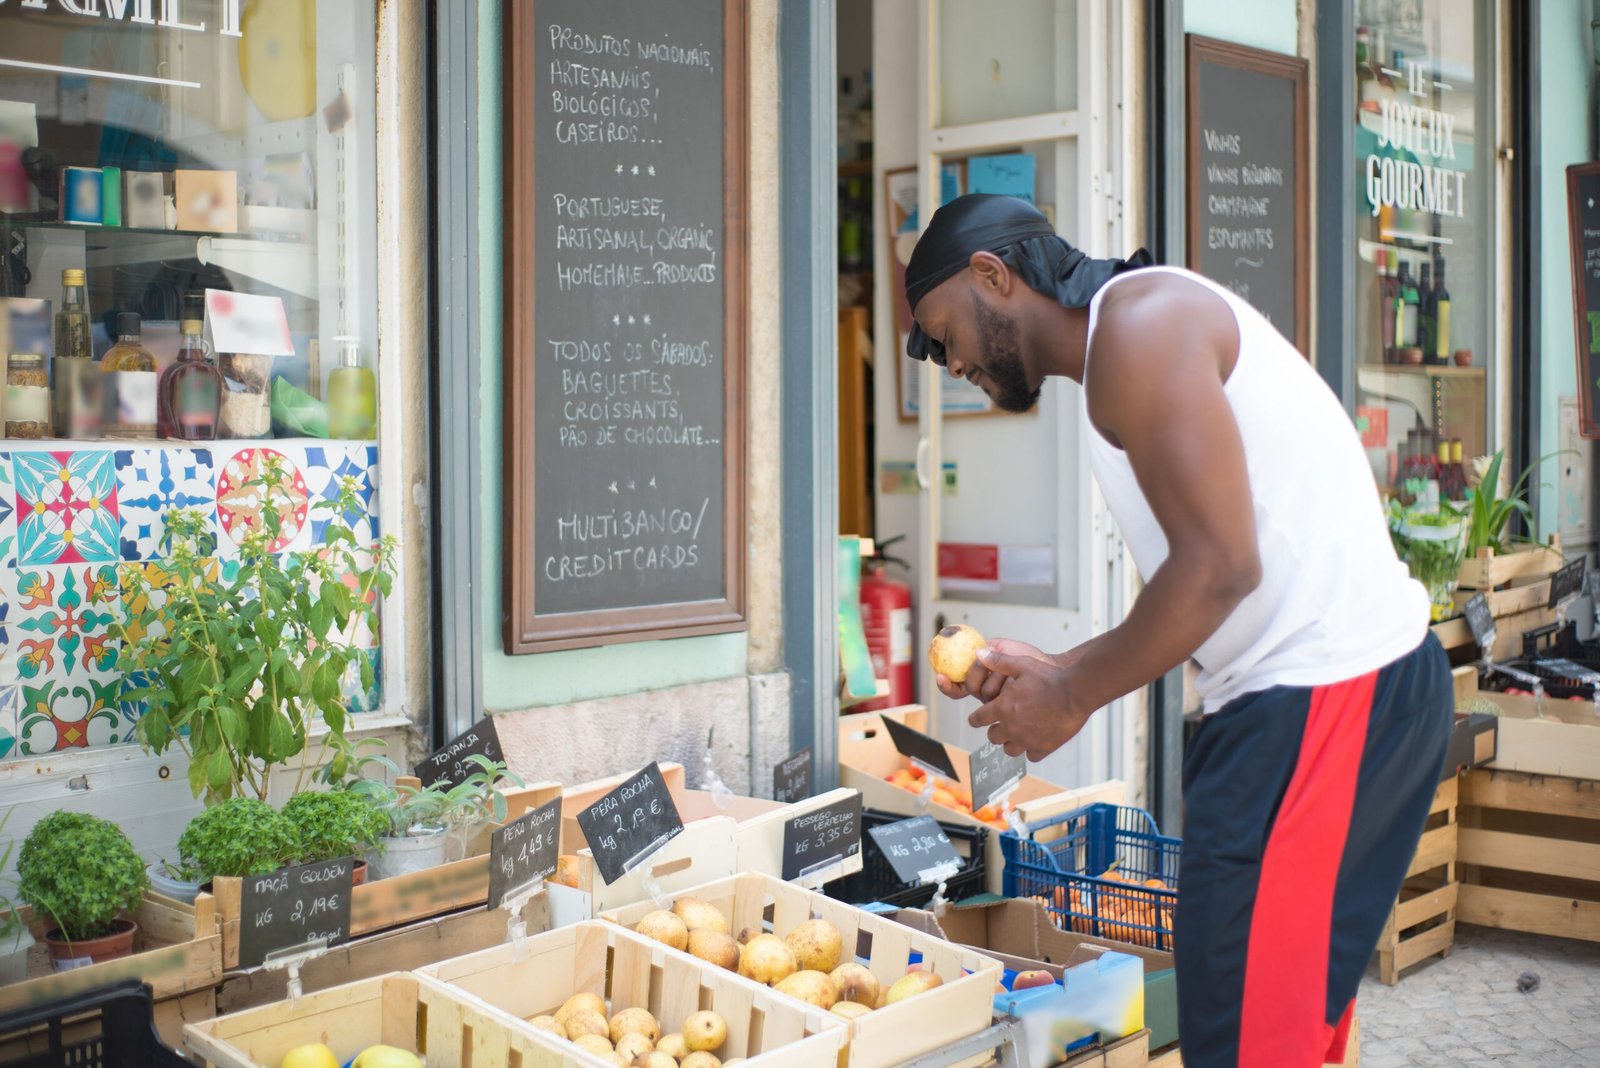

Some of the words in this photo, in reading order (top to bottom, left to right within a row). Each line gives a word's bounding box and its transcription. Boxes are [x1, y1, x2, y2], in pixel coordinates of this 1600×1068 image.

[1409, 63, 1427, 98] LE
[1377, 99, 1456, 160] JOYEUX
[1366, 154, 1466, 218] GOURMET
[548, 339, 611, 362] TODOS
[596, 426, 617, 446] DE
[545, 548, 632, 582] CREDIT
[633, 544, 698, 571] CARDS
[591, 797, 619, 821] PERA
[620, 773, 655, 803] ROCHA
[503, 823, 525, 844] PERA
[530, 807, 555, 831] ROCHA
[327, 894, 339, 910] €
